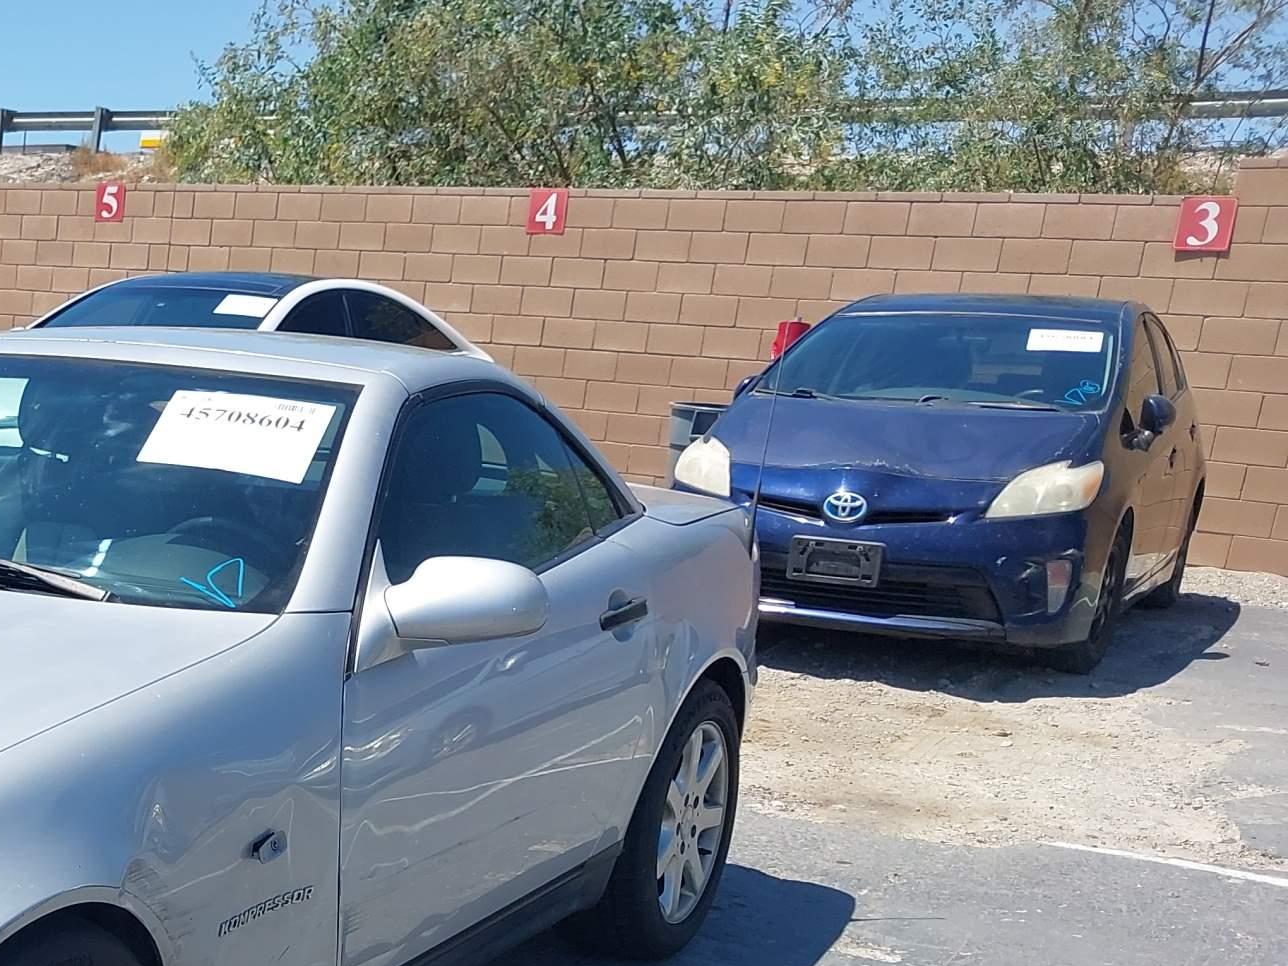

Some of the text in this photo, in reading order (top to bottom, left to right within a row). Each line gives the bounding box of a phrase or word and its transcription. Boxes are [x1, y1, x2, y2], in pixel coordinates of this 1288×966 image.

[101, 186, 118, 218] 5
[535, 192, 557, 230] 4
[1186, 201, 1221, 246] 3
[179, 405, 307, 432] 45708604
[217, 885, 314, 938] KOMPRESSOR
